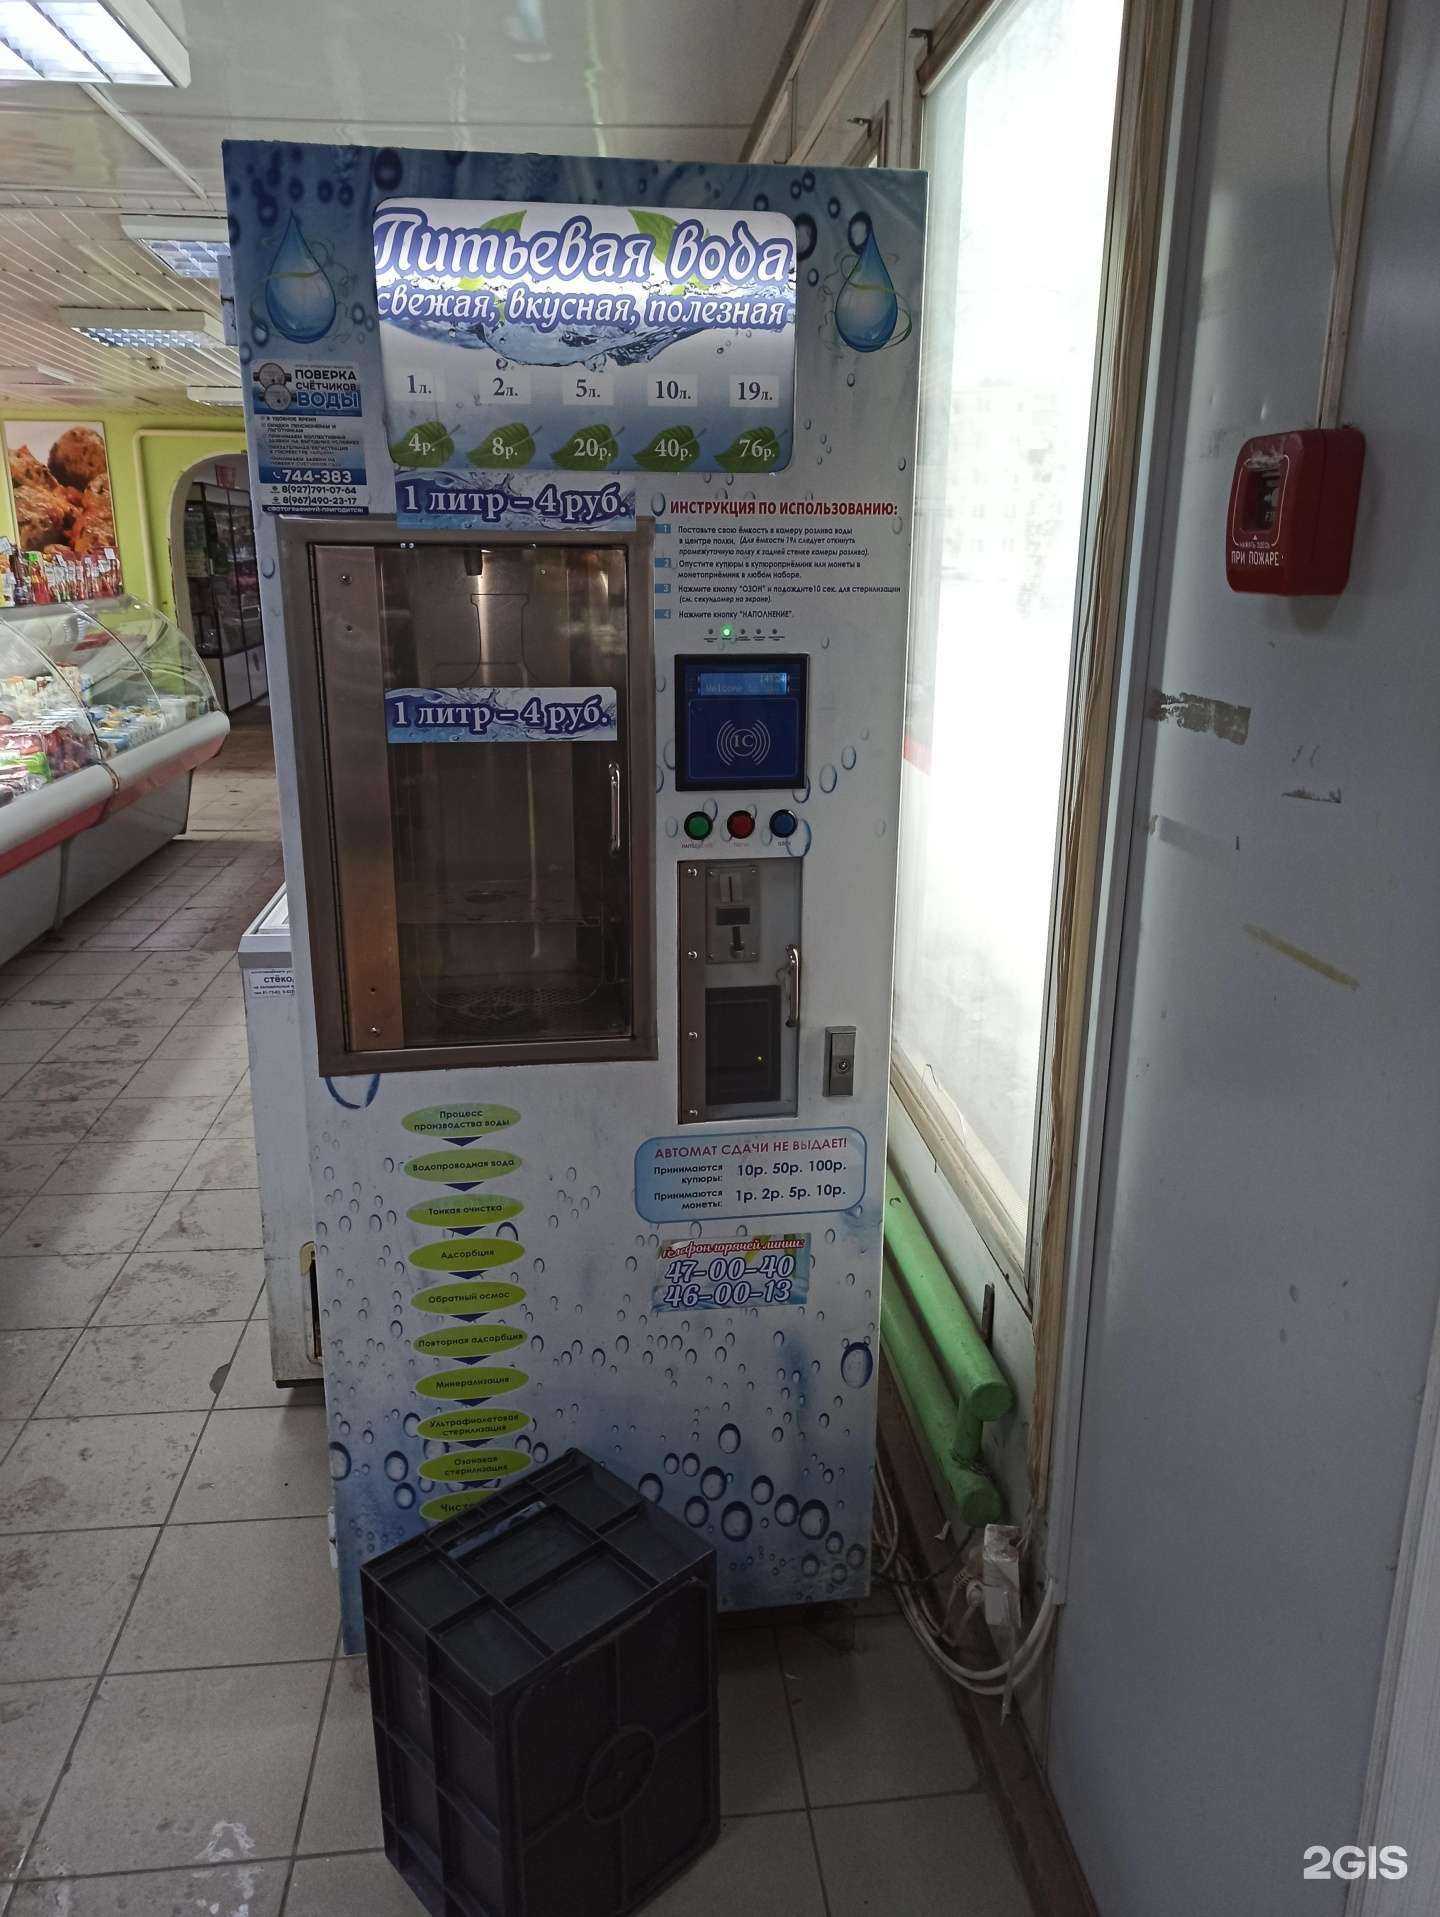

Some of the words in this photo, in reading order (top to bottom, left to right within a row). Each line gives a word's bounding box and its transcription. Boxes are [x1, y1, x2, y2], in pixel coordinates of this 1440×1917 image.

[374, 208, 656, 284] Питьевая
[664, 219, 794, 286] вода
[377, 287, 499, 322] свежая,
[508, 287, 641, 332] вкусная,
[645, 298, 789, 332] полезная
[295, 369, 357, 381] ПОВЕРКА
[296, 380, 357, 391] СЧЁТЧИКОВ
[407, 374, 432, 396] 1л.
[493, 377, 518, 398] 2л.
[576, 379, 601, 399] 5л.
[656, 380, 691, 401] 10л.
[738, 381, 774, 402] 19л.
[296, 391, 359, 410] ВОДЫ
[408, 433, 435, 458] 4р.
[492, 437, 518, 459] 8р.
[574, 438, 612, 460] 20р.
[655, 439, 692, 461] 40р.
[739, 439, 775, 461] 76р.
[282, 469, 352, 483] 744-383
[282, 485, 357, 495] 8(927)791-07-64
[283, 496, 358, 506] 8(967)490-23-17
[404, 485, 419, 512] 1
[428, 490, 505, 520] литр
[564, 486, 626, 521] руб.
[670, 501, 756, 517] ИНСТРУКЦИЯ
[759, 502, 776, 514] ПО
[780, 502, 898, 516] ИСПОЛЬЗОВАНИЮ:
[678, 526, 716, 534] Поставьте
[776, 528, 802, 536] камеру
[835, 528, 853, 536] воды
[678, 560, 714, 569] Опустите
[715, 561, 744, 570] купюры
[1232, 550, 1245, 564] ПРИ
[1248, 551, 1280, 567] ПОЖАРЕ
[678, 586, 711, 594] Нажмите
[712, 586, 738, 595] кнопку
[678, 610, 712, 618] Нажмите
[713, 612, 738, 620] кнопку
[394, 701, 409, 725] 1
[418, 704, 491, 732] литр
[547, 698, 608, 731] руб.
[734, 734, 754, 748] IC
[439, 1109, 483, 1120] Процесс
[414, 1120, 482, 1132] производства
[484, 1118, 510, 1129] воды
[655, 1144, 717, 1160] АВТОМАТ
[722, 1142, 770, 1158] СДАЧИ
[774, 1141, 790, 1152] НЕ
[792, 1138, 848, 1152] ВЫДАЕТ!
[412, 1160, 489, 1173] Водопроводная
[491, 1158, 515, 1169] вода
[654, 1164, 723, 1176] Принимаются
[738, 1164, 768, 1180] 10р.
[772, 1162, 803, 1178] 50р.
[808, 1159, 847, 1175] 100р.
[681, 1174, 723, 1186] купюры:
[654, 1189, 723, 1202] Принимаются
[736, 1189, 758, 1204] 1р.
[762, 1188, 784, 1202] 2р.
[788, 1186, 811, 1201] 5р.
[816, 1184, 846, 1199] 10р.
[428, 1206, 461, 1217] Тонкая
[464, 1204, 502, 1215] очистка
[681, 1201, 723, 1210] монеты:
[440, 1248, 495, 1261] Адсорбция
[664, 1255, 796, 1283] 47-00-40
[428, 1292, 477, 1304] Обратный
[479, 1290, 510, 1301] осмос
[664, 1280, 793, 1308] 46-00-13
[418, 1338, 469, 1348] Повторная
[471, 1332, 524, 1346] адсорбция
[436, 1376, 510, 1390] Минерализация
[429, 1412, 519, 1429] Ультрафиолетовая
[442, 1424, 508, 1437] стерилизация
[454, 1456, 498, 1466] Озоновая
[444, 1464, 508, 1477] стерилизация
